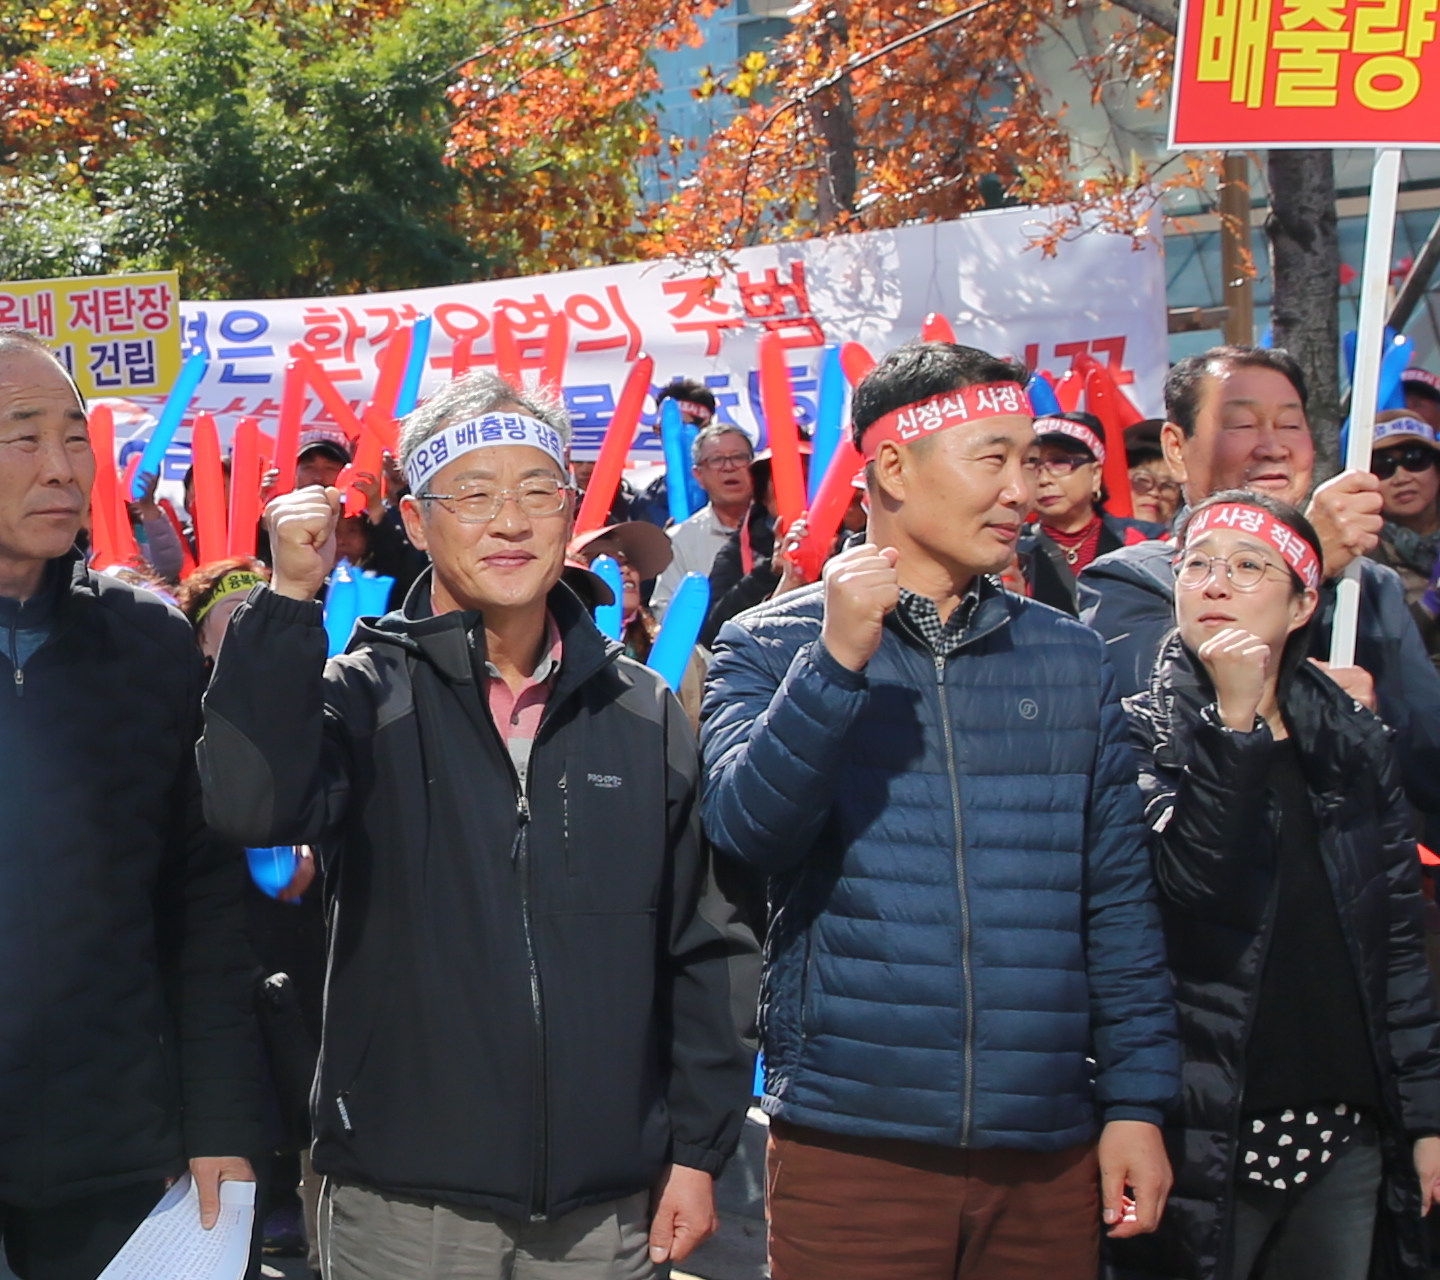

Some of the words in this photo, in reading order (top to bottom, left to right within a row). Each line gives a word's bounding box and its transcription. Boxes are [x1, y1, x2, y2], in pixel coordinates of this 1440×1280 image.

[69, 284, 171, 335] 저탄장
[661, 261, 826, 357] 주범
[89, 339, 156, 387] 건립
[452, 415, 527, 447] 배출량
[895, 395, 969, 440] 신정식
[976, 386, 1019, 414] 사장
[1213, 505, 1265, 533] 사장
[1269, 523, 1308, 568] 적극
